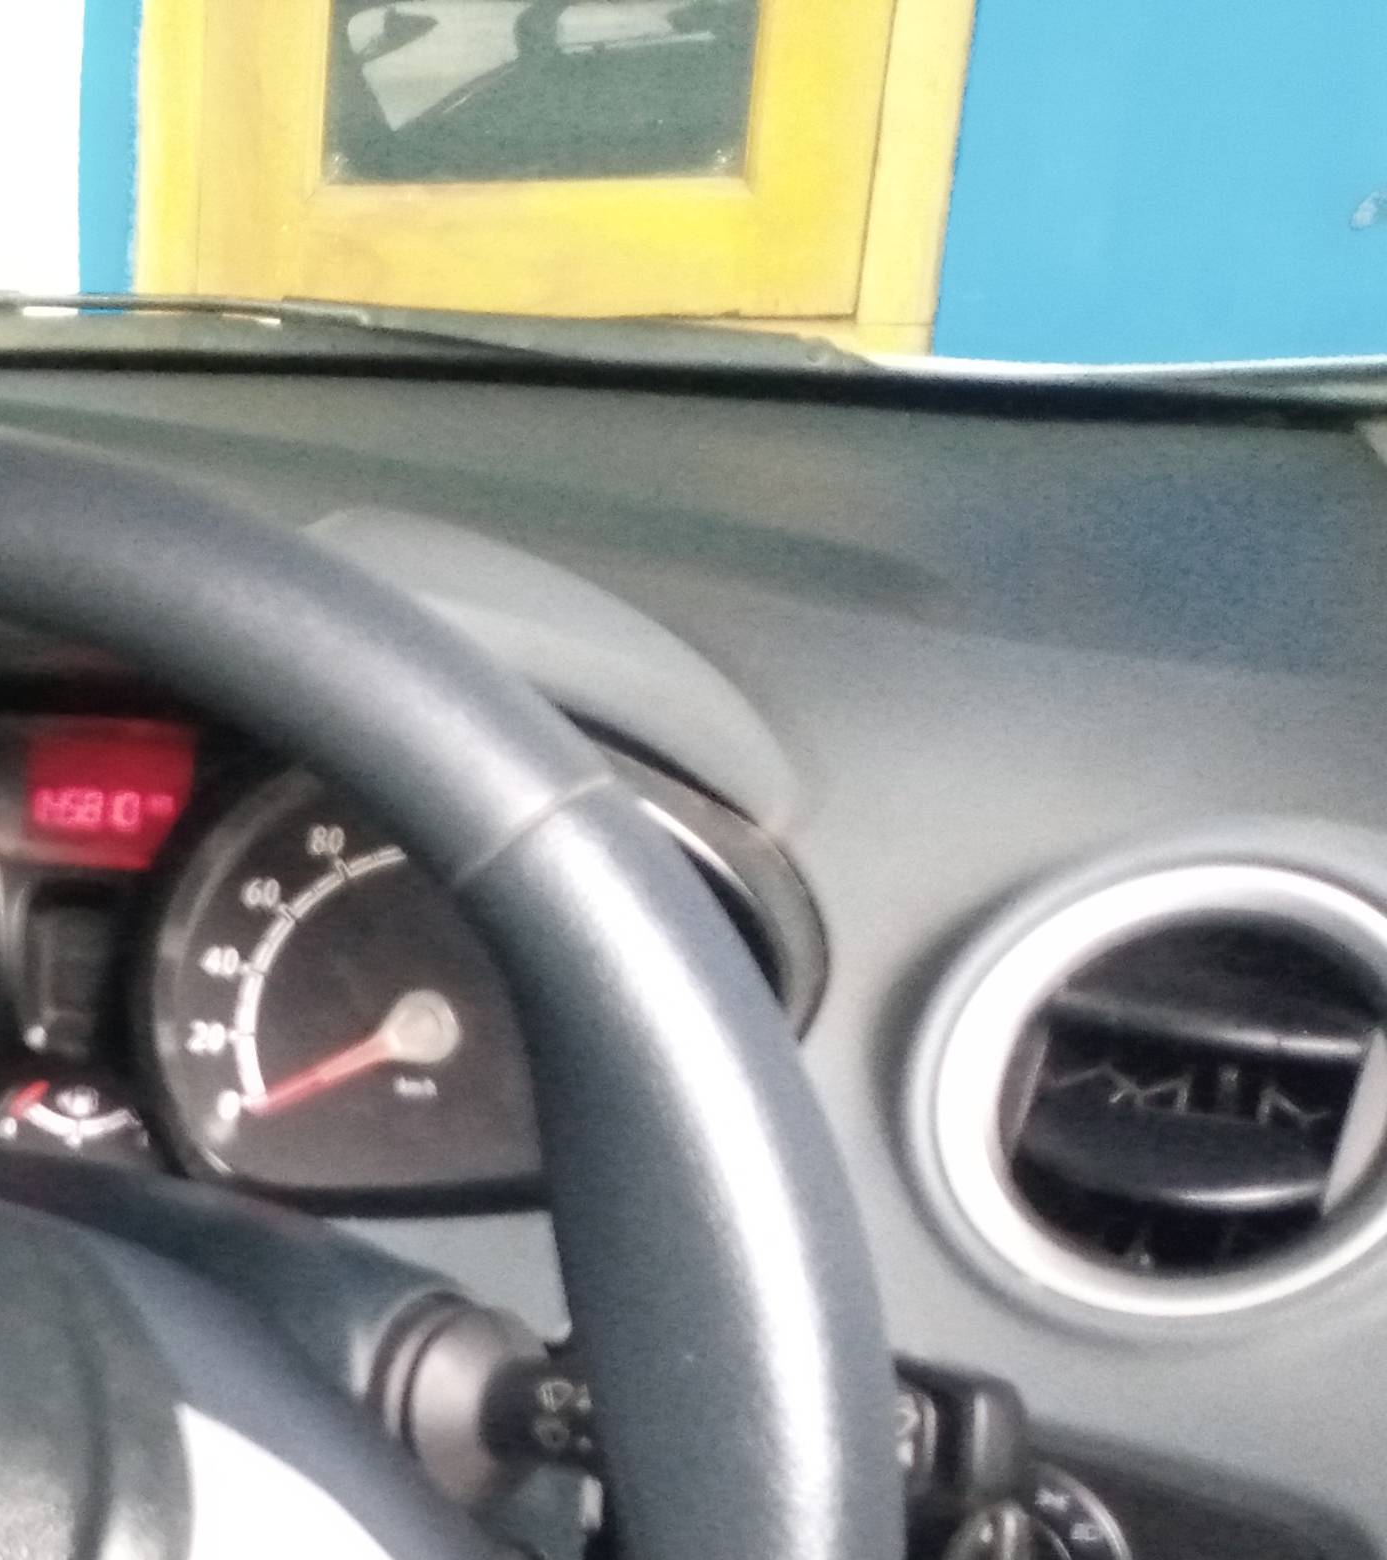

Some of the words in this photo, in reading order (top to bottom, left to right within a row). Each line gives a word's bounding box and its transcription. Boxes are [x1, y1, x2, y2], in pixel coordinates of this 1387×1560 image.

[308, 824, 345, 856] 80
[241, 878, 280, 909] 60
[200, 946, 240, 978] 40
[189, 1020, 226, 1055] 20
